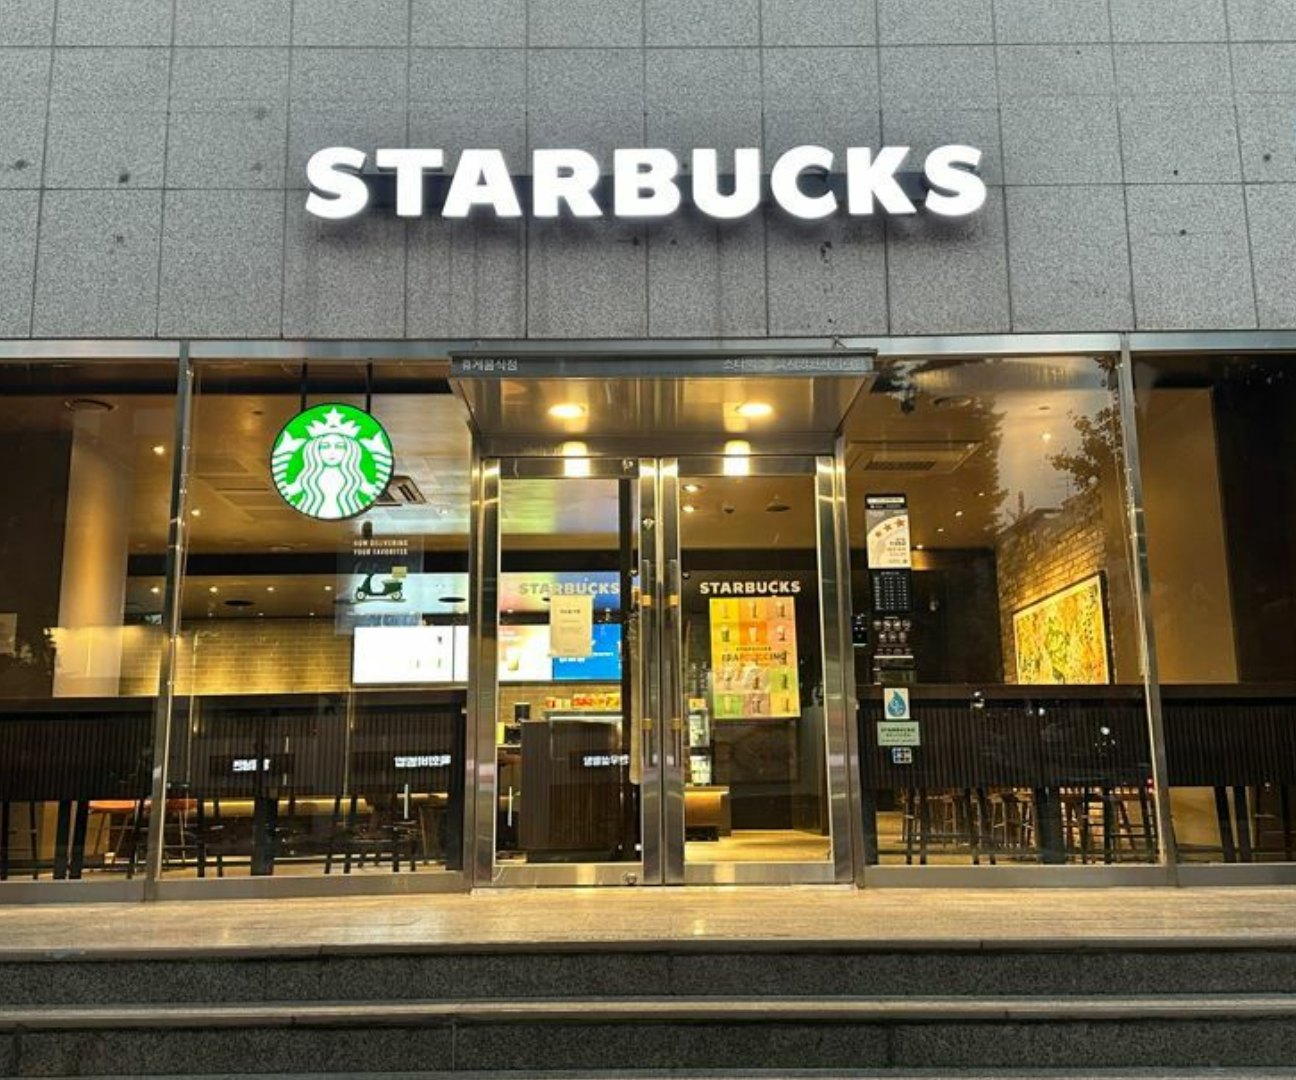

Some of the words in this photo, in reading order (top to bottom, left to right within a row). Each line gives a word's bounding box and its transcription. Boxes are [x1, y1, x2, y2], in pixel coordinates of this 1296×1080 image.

[304, 145, 987, 219] STARBUCKS
[519, 582, 620, 594] STARBUCKS
[699, 581, 801, 594] STARBUCKS
